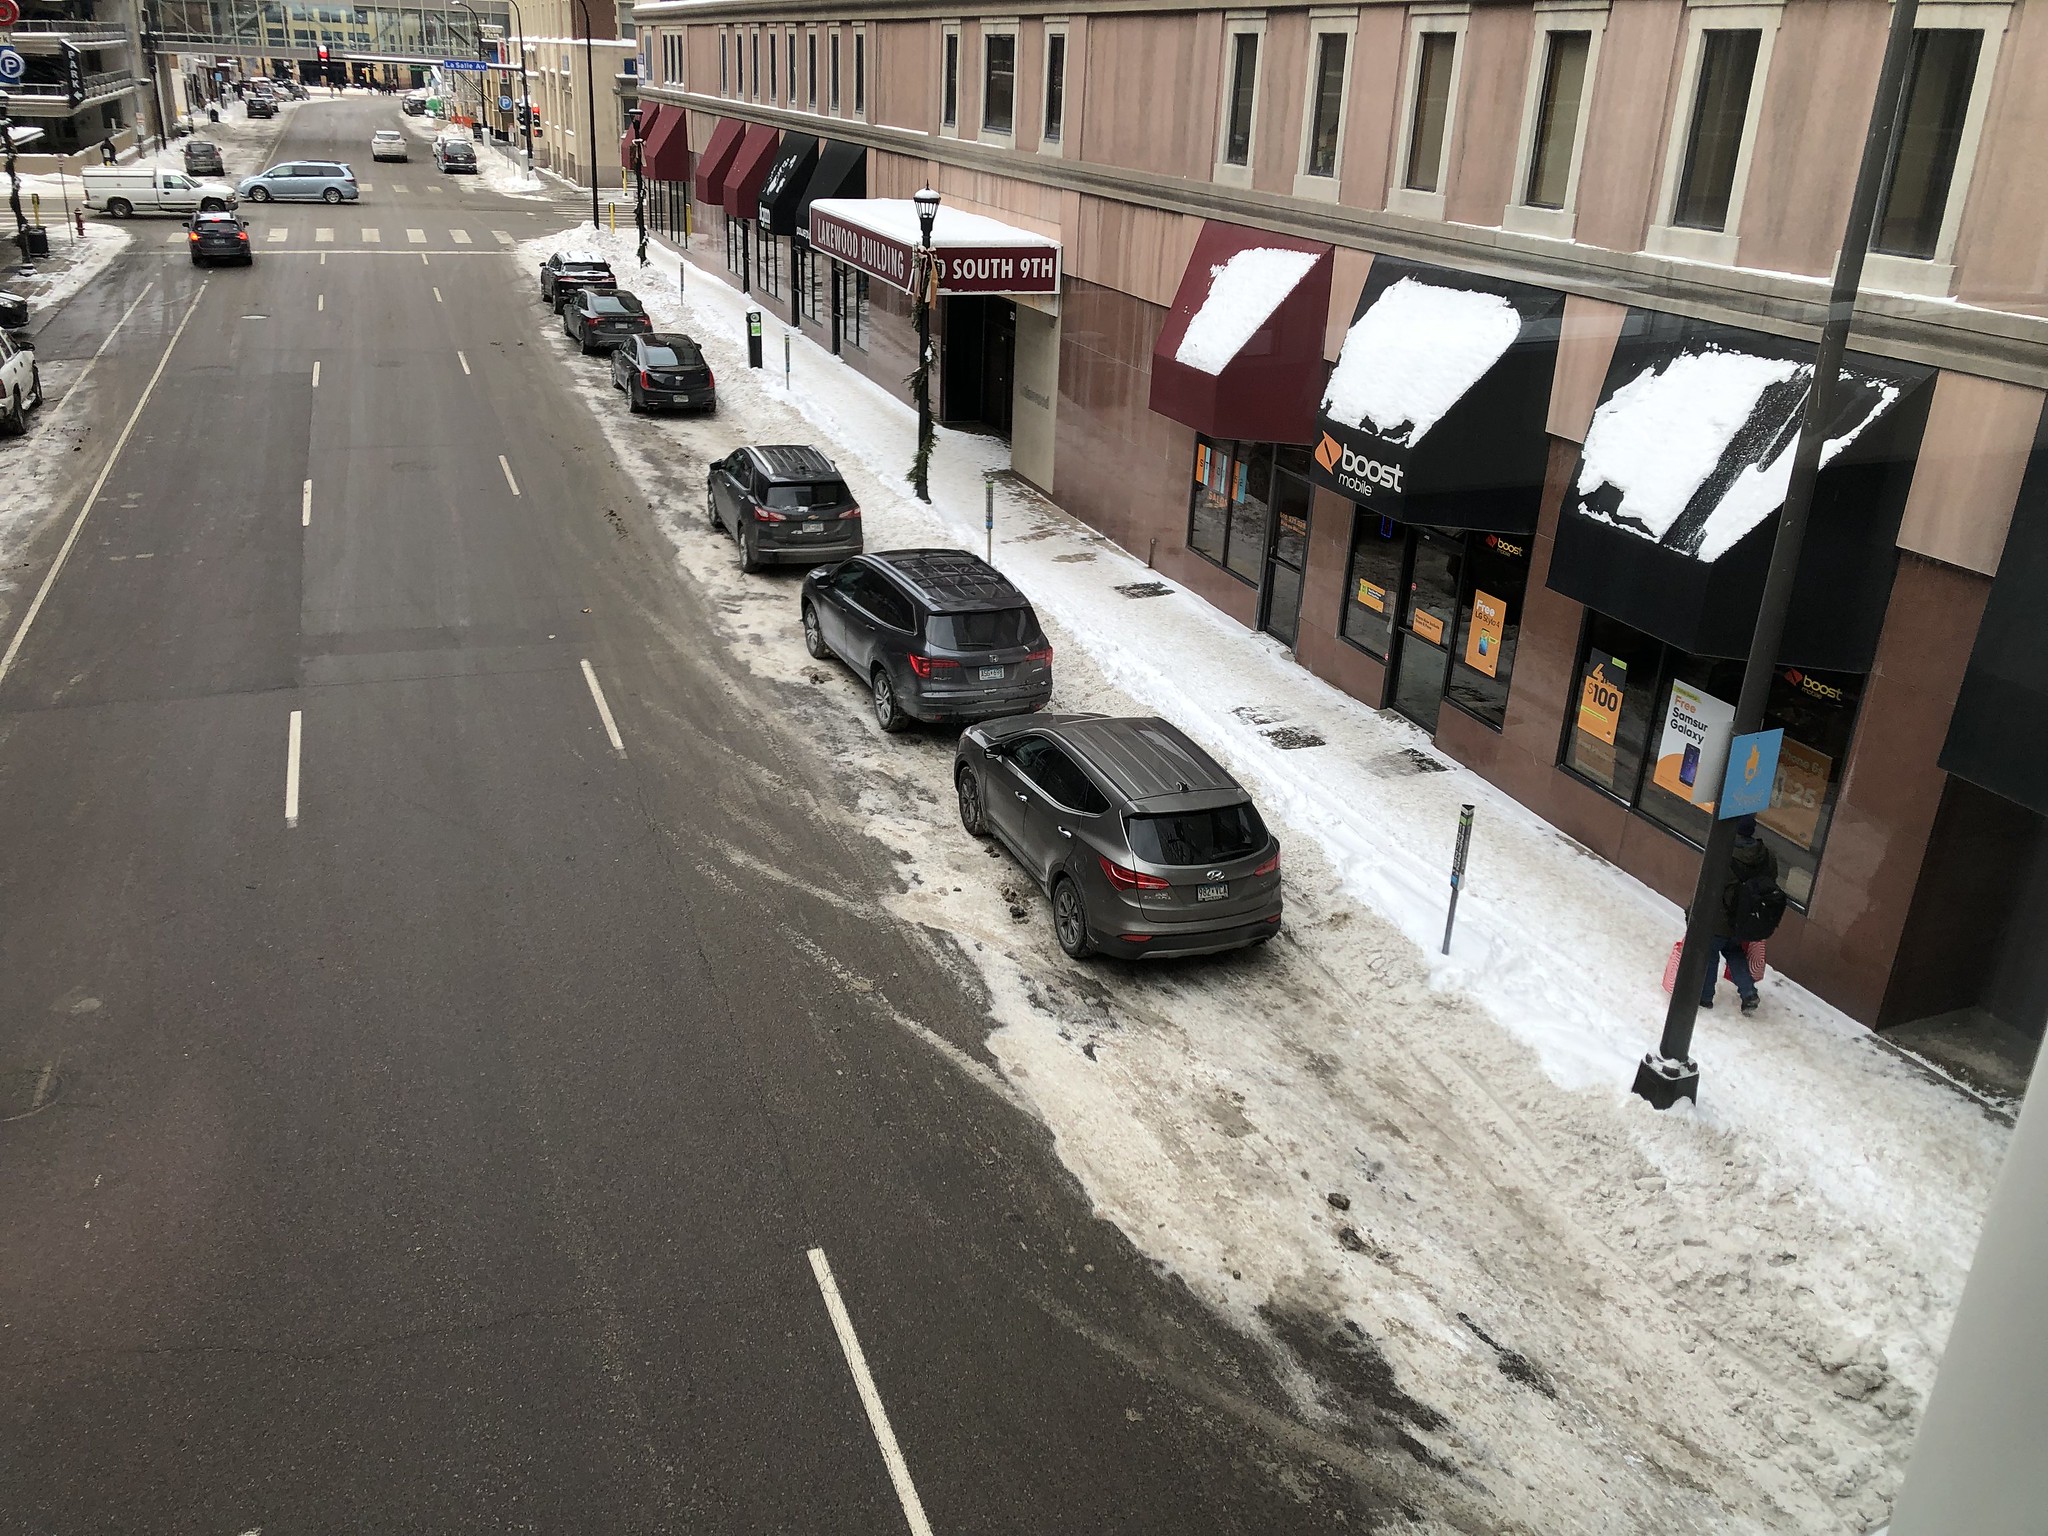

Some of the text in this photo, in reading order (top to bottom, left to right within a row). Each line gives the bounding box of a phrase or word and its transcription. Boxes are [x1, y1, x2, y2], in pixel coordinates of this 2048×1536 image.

[67, 50, 80, 89] PARK
[816, 217, 858, 259] LAKEWOOD
[861, 237, 904, 280] BUILDING
[952, 257, 1013, 279] SOUTH
[1021, 257, 1053, 279] 9TH
[1340, 442, 1404, 493] boost
[1338, 473, 1372, 497] mobile
[1497, 537, 1523, 557] boost
[1475, 598, 1496, 617] Free
[1475, 610, 1484, 621] LG
[1592, 662, 1605, 684] 4
[1587, 681, 1618, 712] $100
[1803, 674, 1843, 701] boost
[1674, 694, 1697, 714] Free
[1670, 718, 1705, 745] Galaxy
